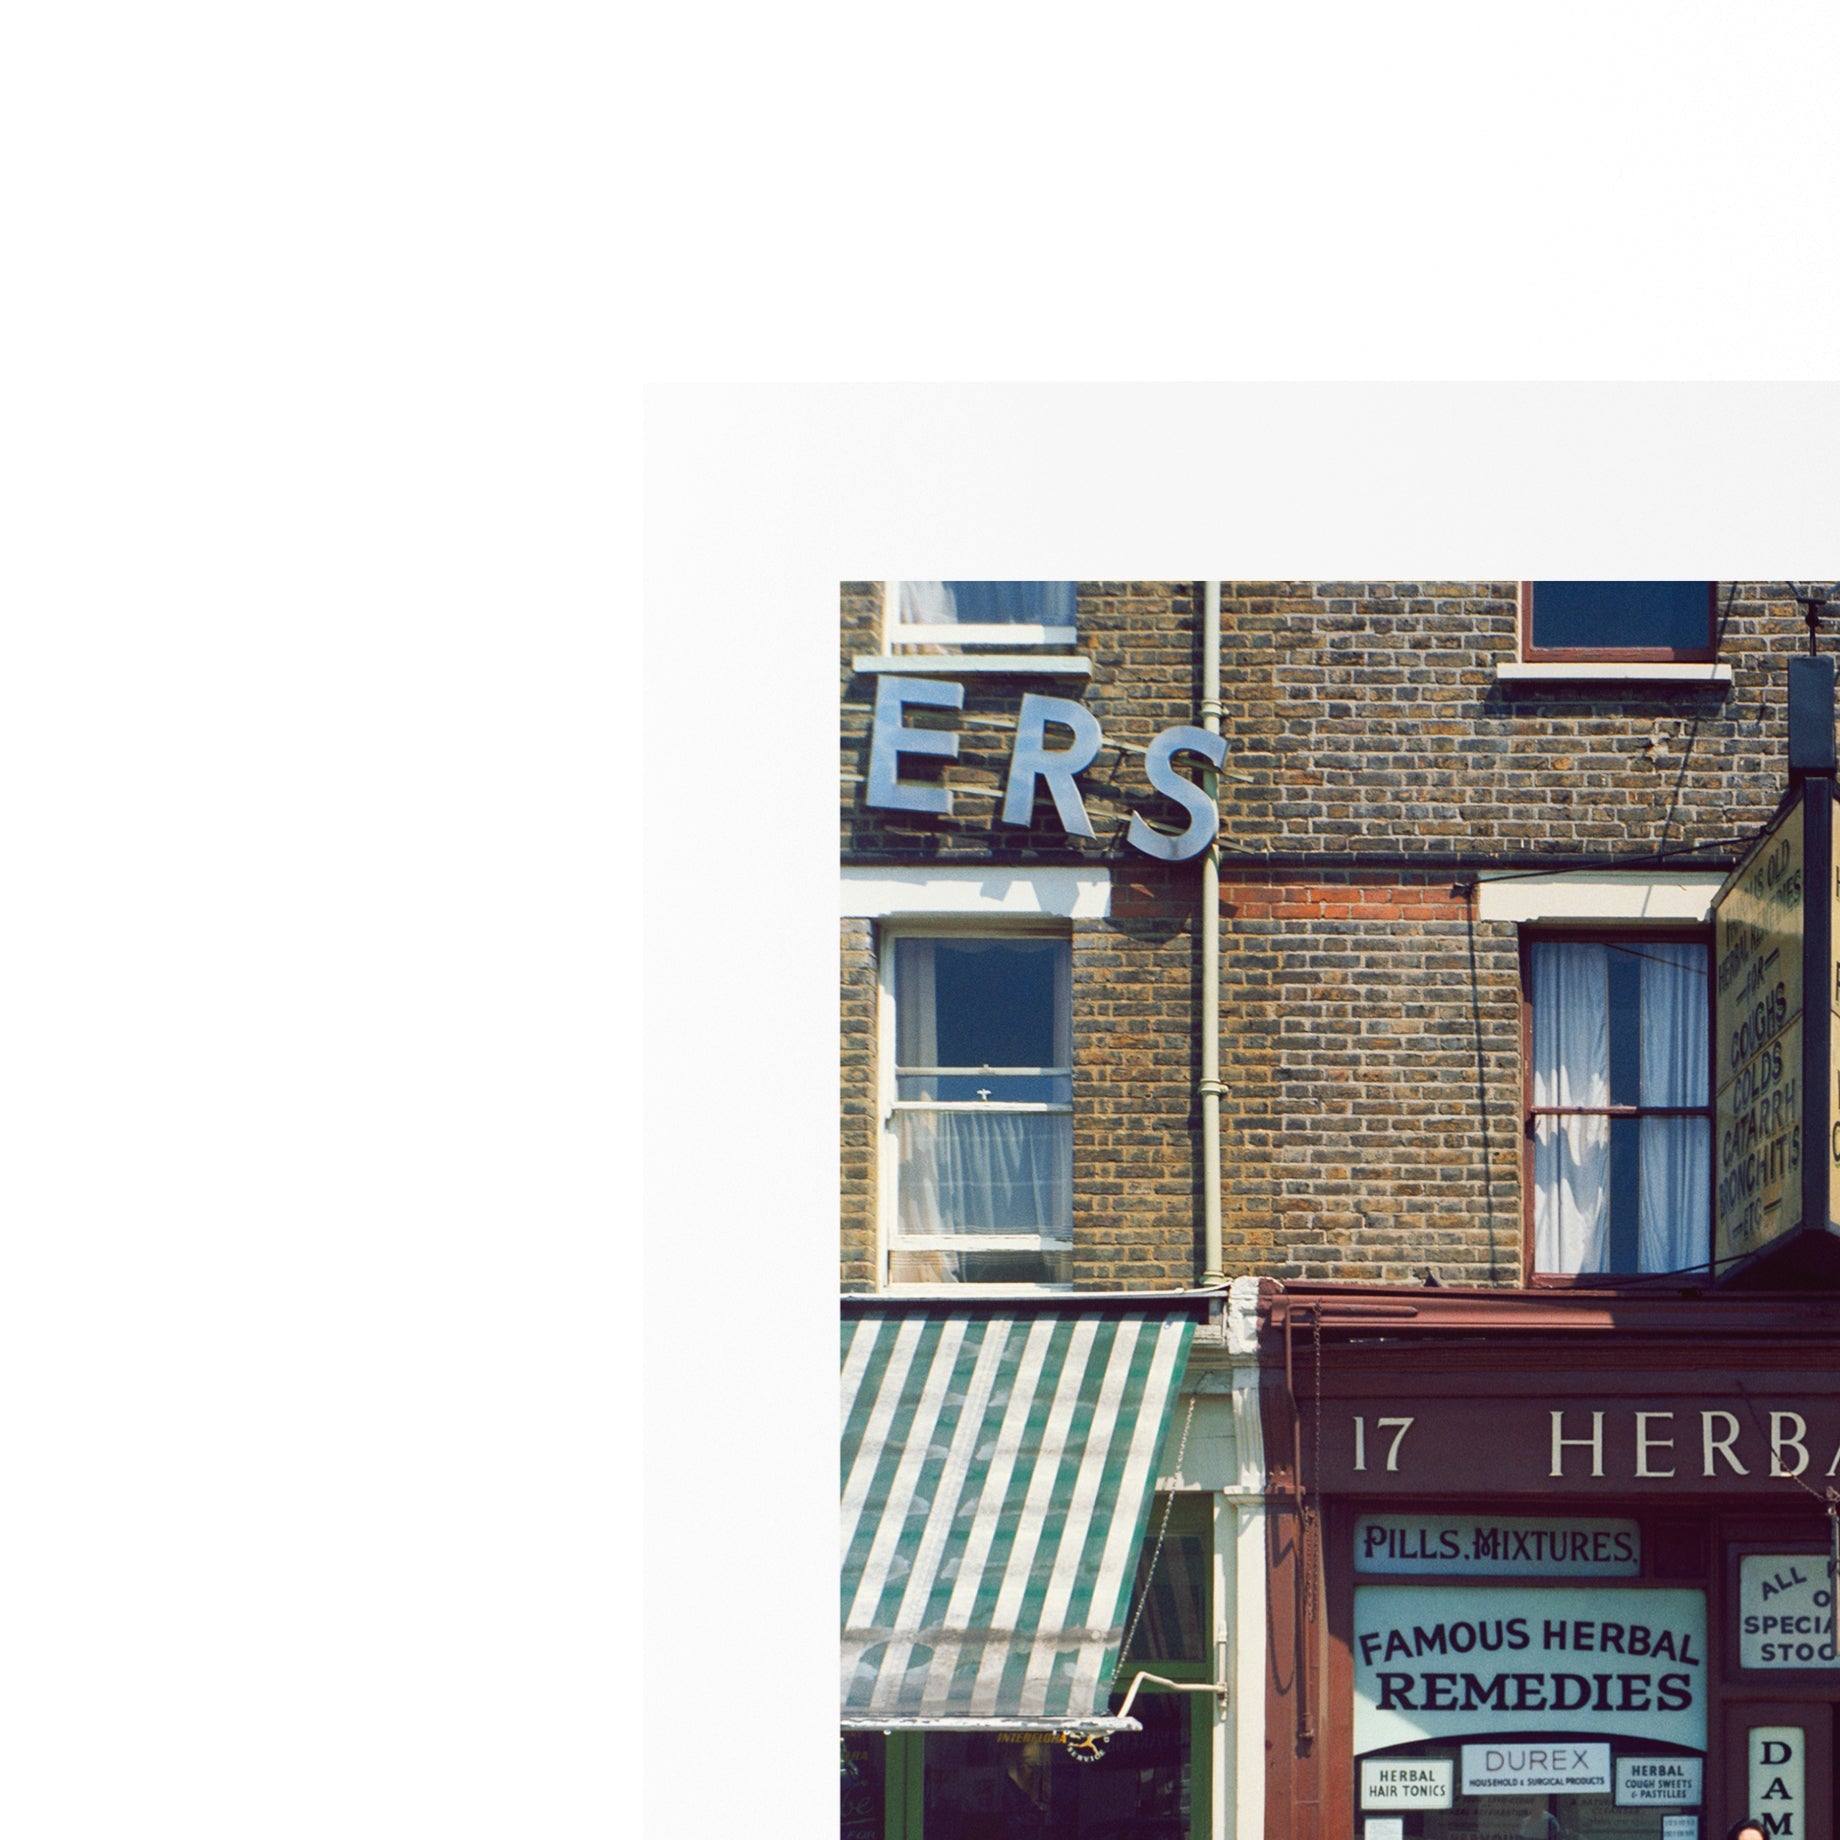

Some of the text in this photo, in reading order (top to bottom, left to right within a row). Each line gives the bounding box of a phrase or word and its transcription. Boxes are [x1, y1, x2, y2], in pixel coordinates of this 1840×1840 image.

[865, 675, 1228, 861] ERS
[1767, 838, 1790, 890] OLD
[1747, 955, 1765, 1000] FOR
[1731, 981, 1786, 1073] COUGHS
[1733, 1041, 1783, 1115] COLDS
[1723, 1078, 1796, 1168] CATARRH
[1719, 1125, 1800, 1225] BRONCHITIS
[1353, 1416, 1415, 1472] 17
[1761, 1567, 1807, 1601] ALL
[1359, 1618, 1699, 1666] FAMOUS HERBAL
[1375, 1673, 1693, 1711] REMEDIES
[1380, 1770, 1435, 1782] HERBAL
[1469, 1778, 1518, 1787] HOUSEHOLD
[1527, 1777, 1565, 1786] SURGICAL
[1565, 1776, 1605, 1785] PRODUCTS
[1486, 1750, 1589, 1772] DUREX
[1632, 1765, 1684, 1776] HERBAL
[1369, 1785, 1446, 1797] HAIR TONICS
[1625, 1779, 1692, 1788] COUGH SWEETS
[1640, 1790, 1686, 1798] PASTILLES
